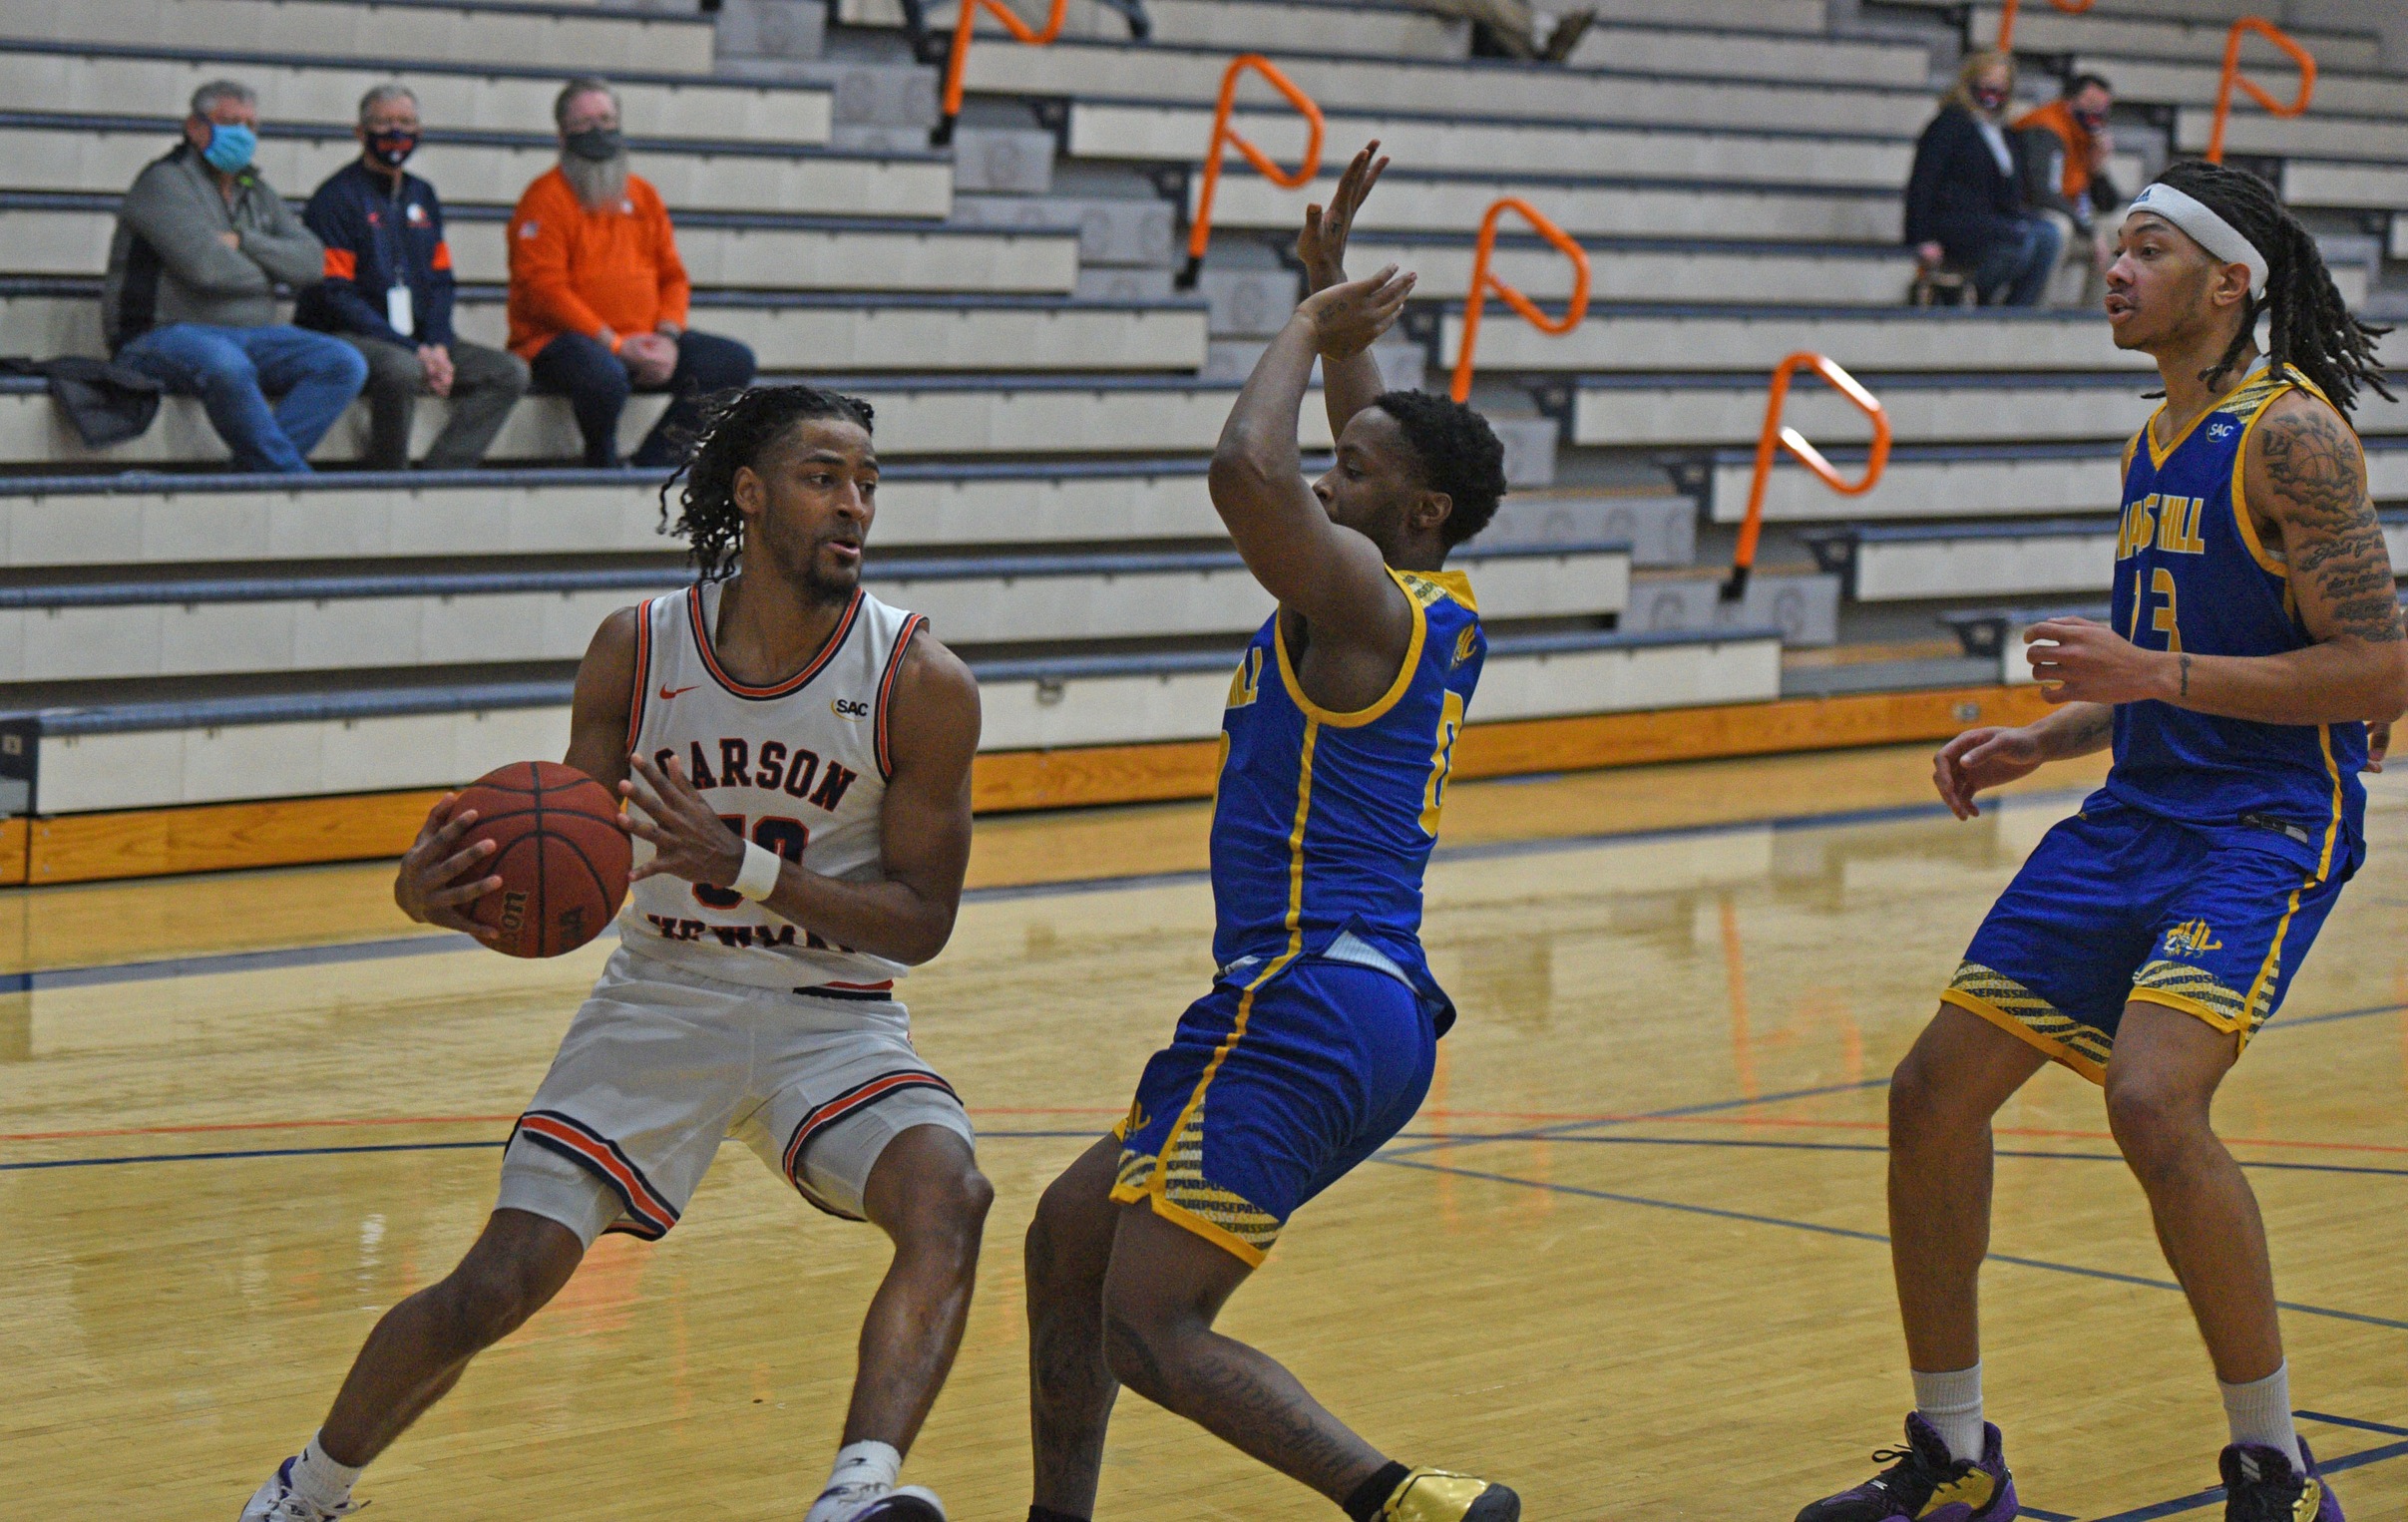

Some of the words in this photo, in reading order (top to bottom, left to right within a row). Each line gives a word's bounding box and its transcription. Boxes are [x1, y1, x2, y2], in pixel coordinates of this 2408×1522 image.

[2208, 423, 2234, 438] SAC
[2157, 495, 2206, 556] HILL
[836, 699, 869, 717] SAC
